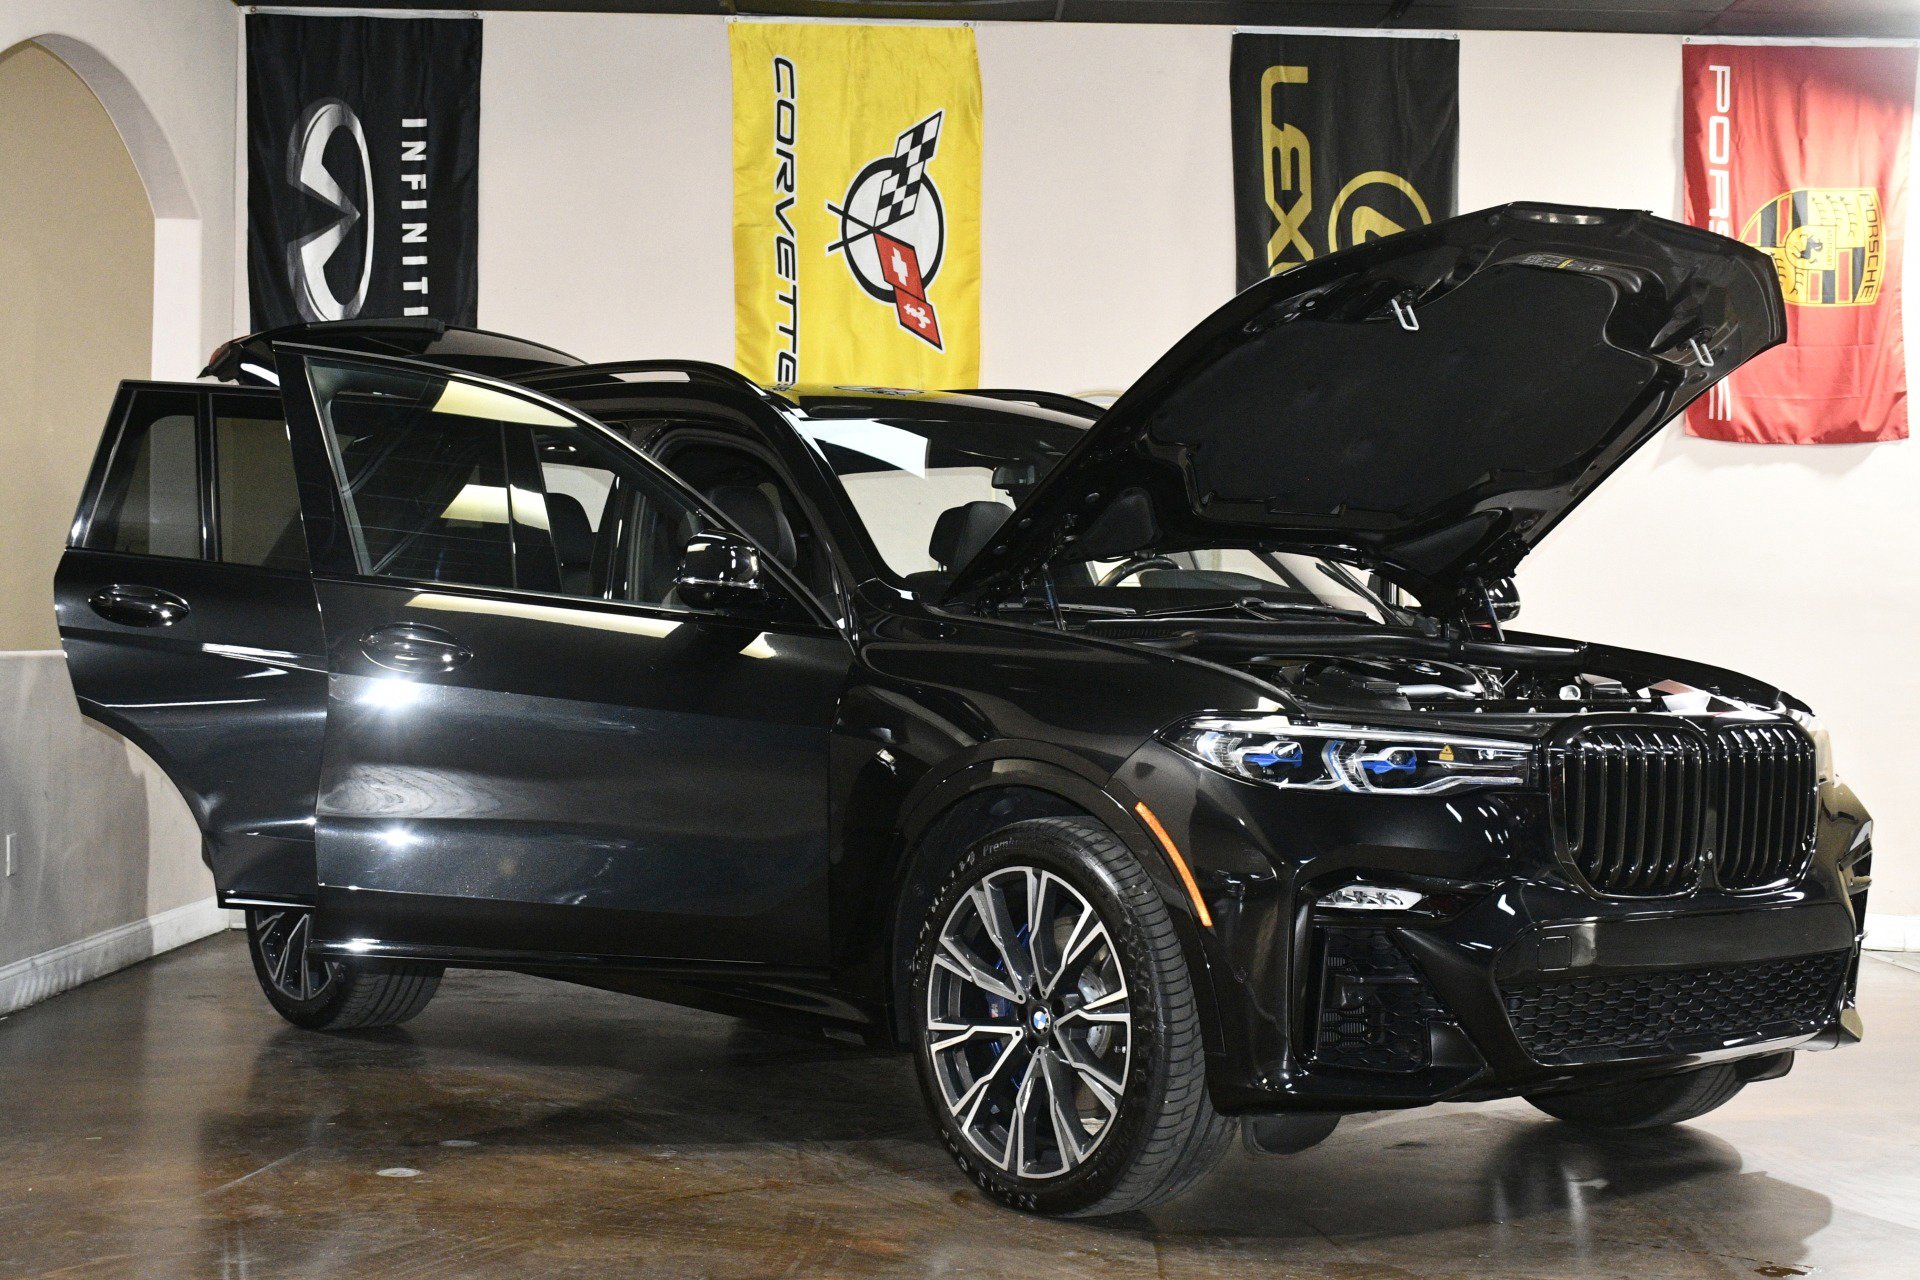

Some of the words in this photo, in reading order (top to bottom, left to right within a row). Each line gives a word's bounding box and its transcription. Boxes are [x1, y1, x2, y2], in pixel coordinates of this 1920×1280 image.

[401, 118, 428, 316] INFINITI
[773, 56, 798, 385] CORVETTE
[1261, 65, 1314, 277] LEX
[1708, 65, 1732, 422] PORE
[1859, 193, 1880, 299] PORSCHE
